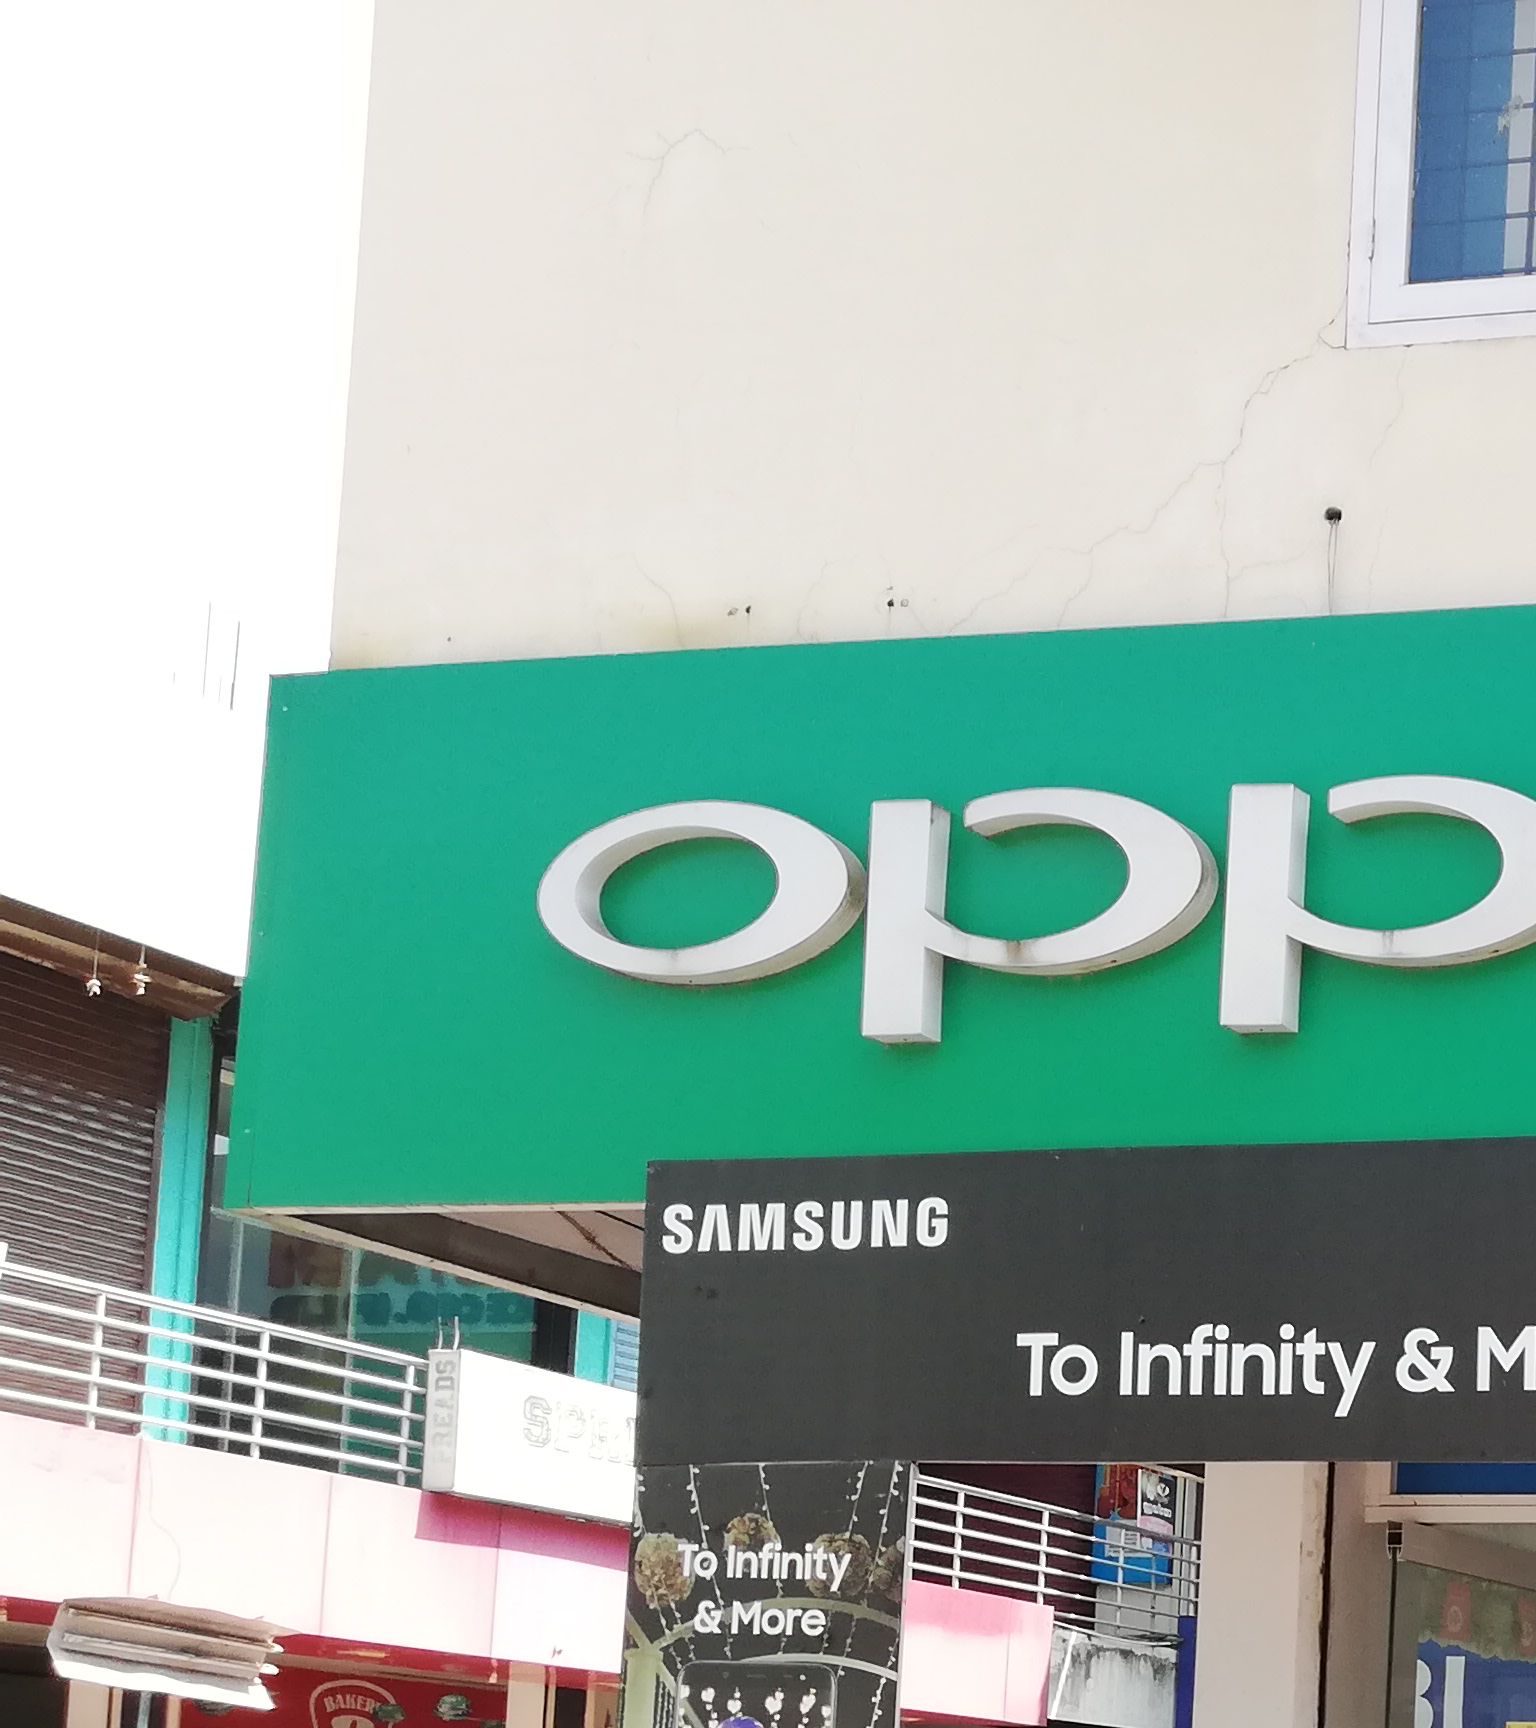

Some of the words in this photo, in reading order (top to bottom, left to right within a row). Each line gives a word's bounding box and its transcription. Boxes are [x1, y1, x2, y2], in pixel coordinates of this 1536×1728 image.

[662, 1196, 950, 1256] SAMSUNG
[1015, 1331, 1101, 1397] To
[1116, 1322, 1378, 1419] Infinity
[1394, 1331, 1455, 1394] &
[678, 1543, 718, 1580] To
[726, 1542, 852, 1593] Infinity
[694, 1600, 723, 1634] &
[730, 1600, 826, 1637] More
